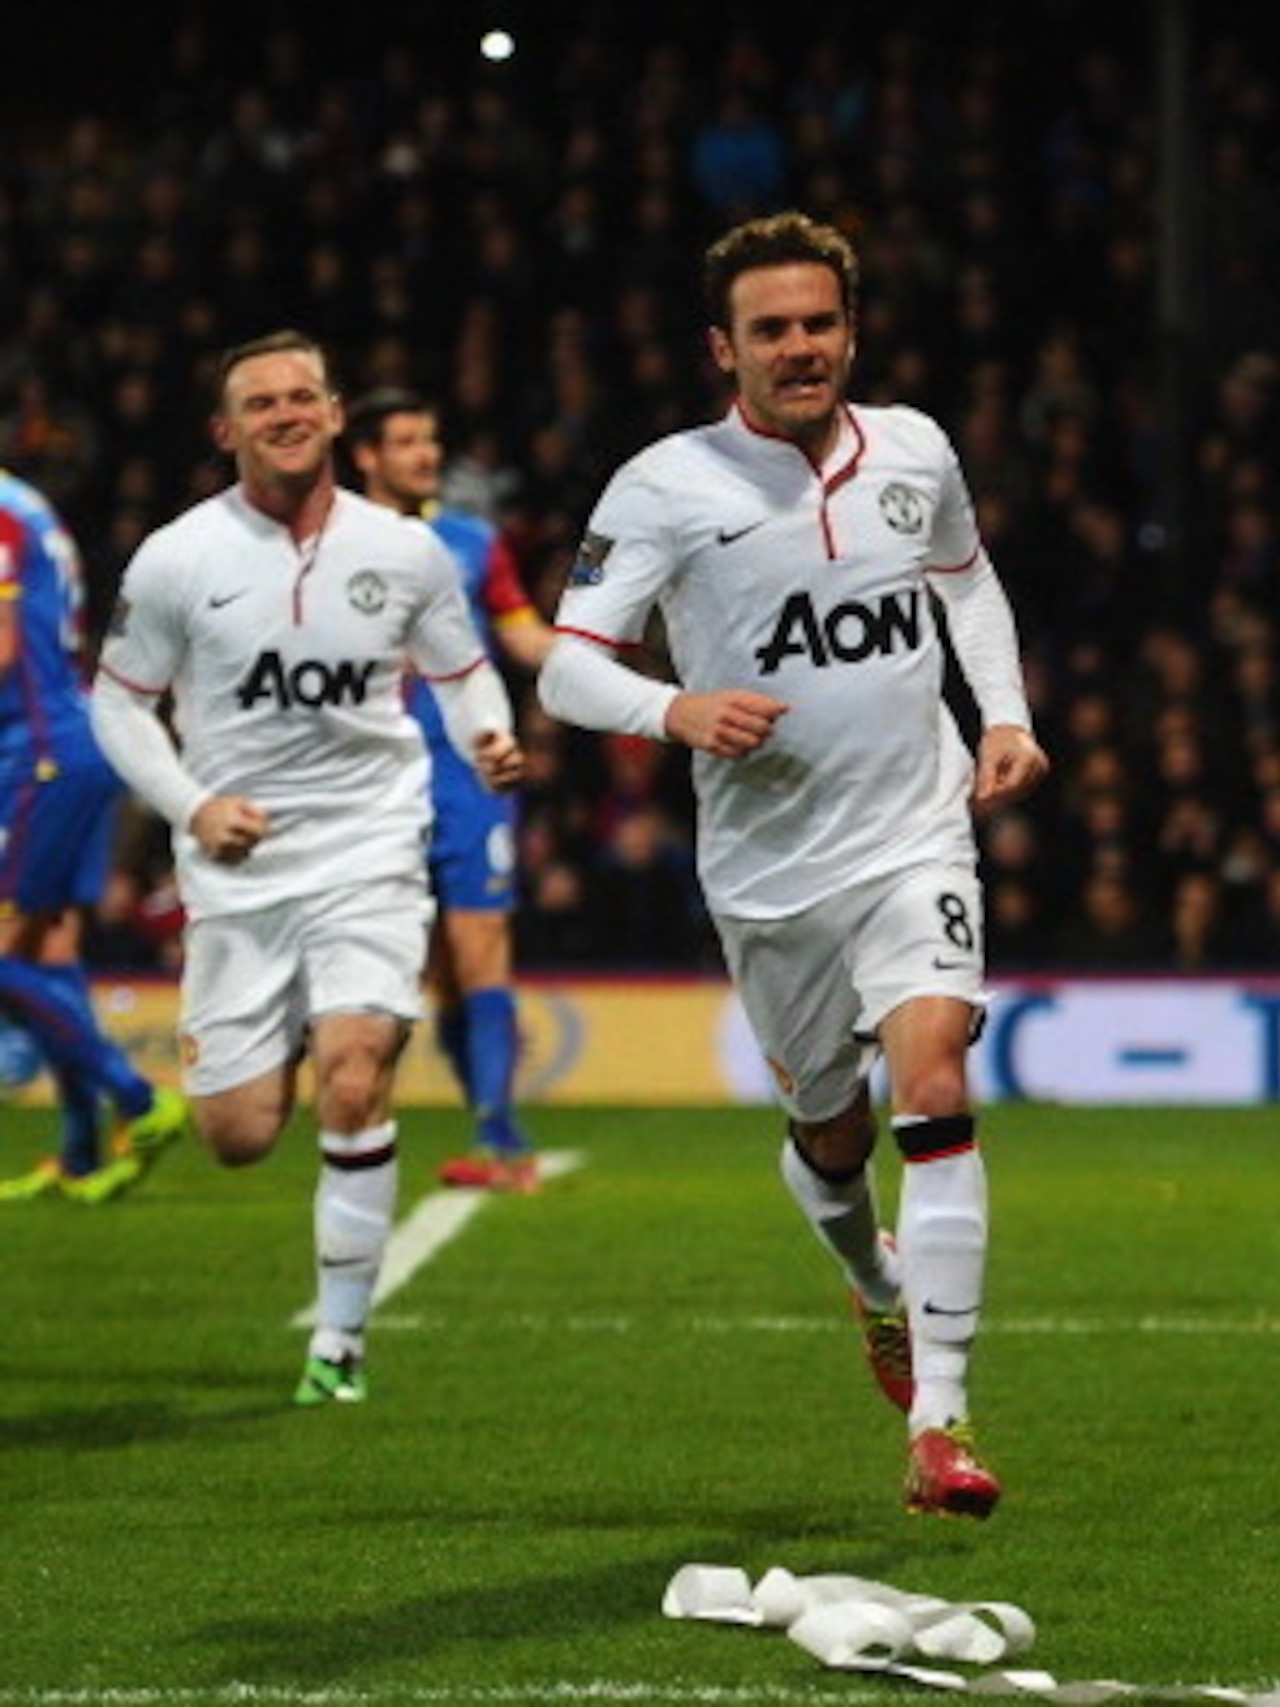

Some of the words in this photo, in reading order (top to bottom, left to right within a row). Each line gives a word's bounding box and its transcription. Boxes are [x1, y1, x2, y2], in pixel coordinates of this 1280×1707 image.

[754, 589, 920, 677] AON
[236, 648, 380, 713] AON
[937, 892, 973, 952] 8
